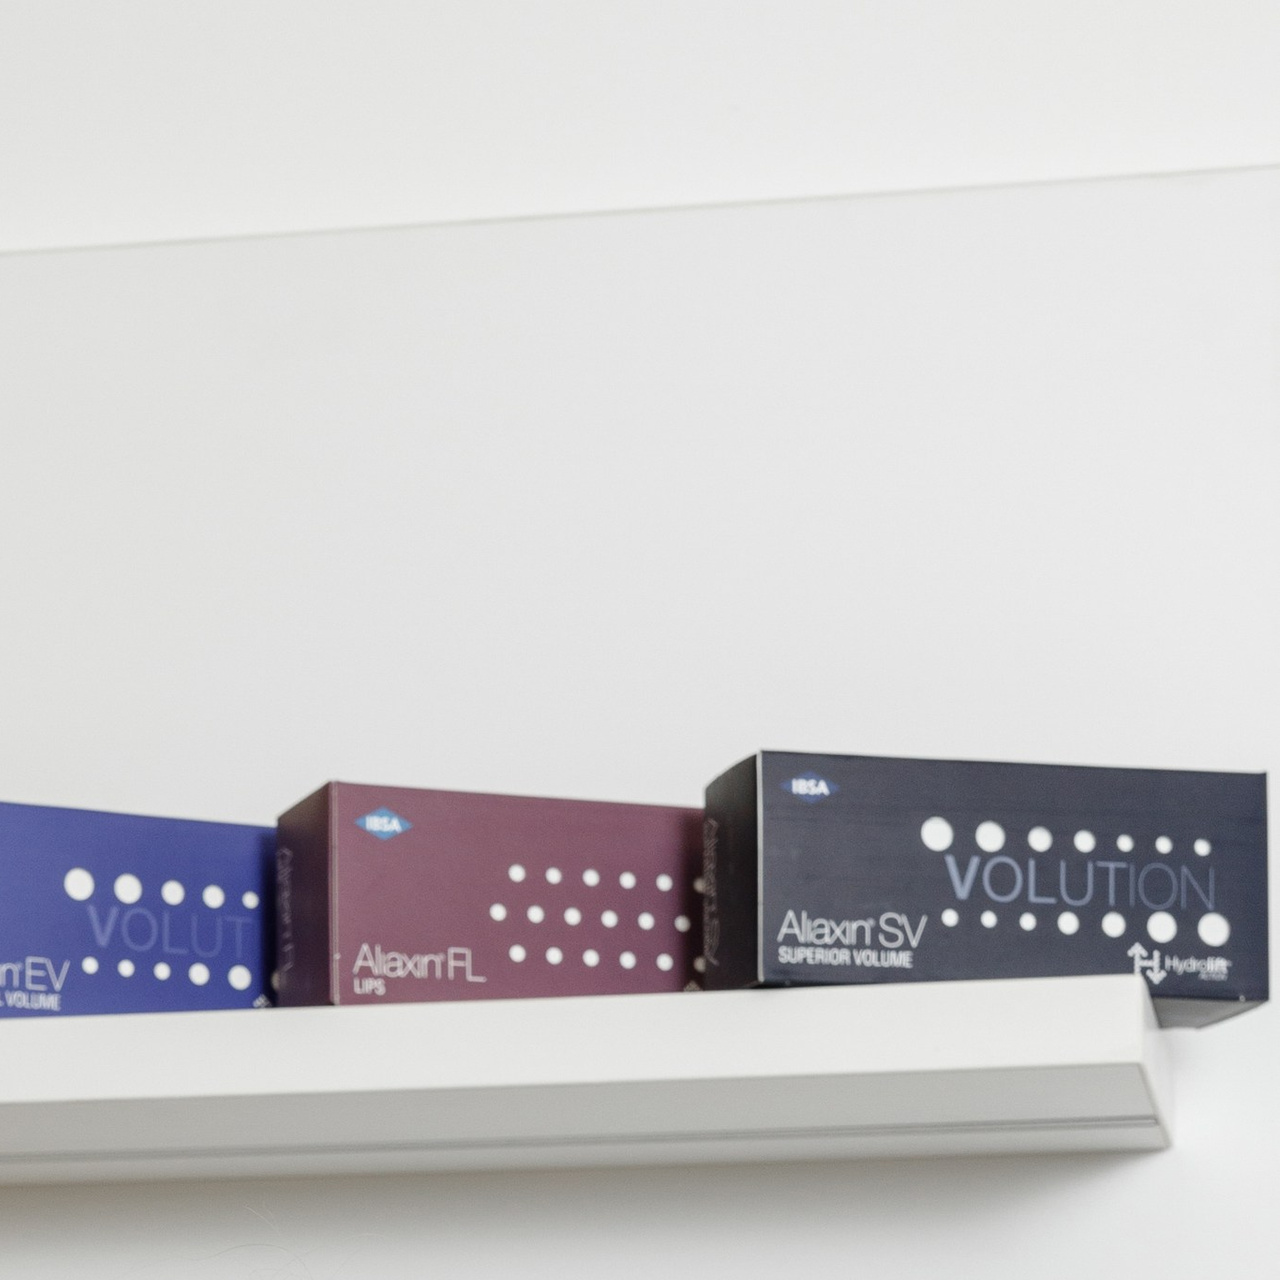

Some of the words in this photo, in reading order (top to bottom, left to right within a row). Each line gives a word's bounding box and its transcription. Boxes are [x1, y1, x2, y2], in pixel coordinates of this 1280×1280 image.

[791, 779, 831, 796] IBSA
[365, 816, 402, 833] IBSA
[944, 854, 1216, 911] VOLUTION
[86, 905, 253, 958] VOLUT
[878, 911, 928, 949] SV
[447, 946, 487, 982] FL
[778, 945, 851, 966] SUPERIOR
[852, 948, 914, 969] VOLUME
[25, 955, 71, 992] EV
[353, 977, 386, 996] LIPS
[4, 989, 61, 1012] VOLUME
